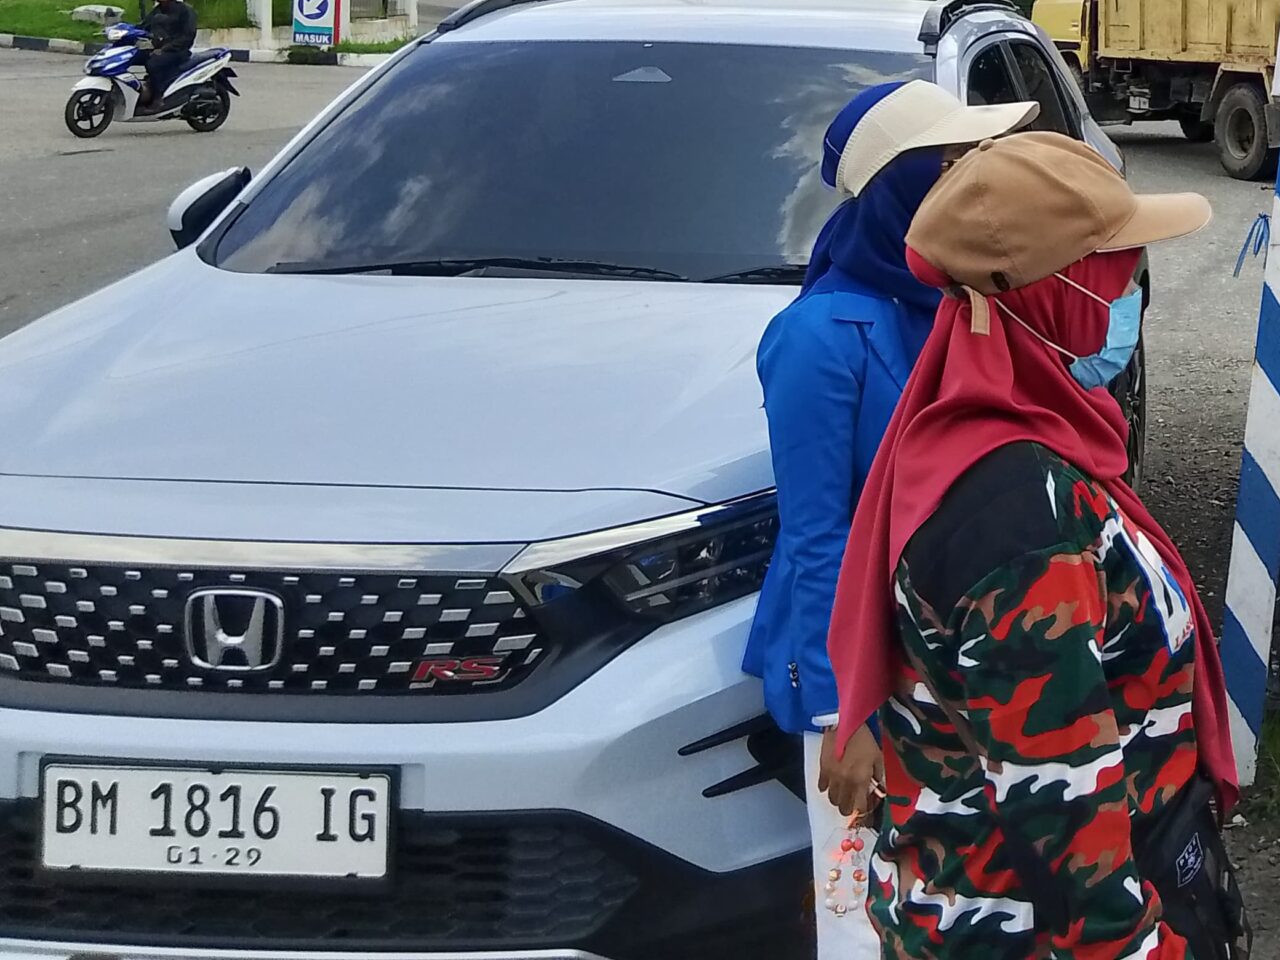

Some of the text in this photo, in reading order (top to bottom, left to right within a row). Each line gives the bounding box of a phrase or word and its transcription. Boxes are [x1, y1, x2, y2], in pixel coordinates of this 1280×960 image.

[295, 31, 330, 45] MASUK
[412, 654, 508, 683] RS
[55, 778, 378, 844] BM 1816 IG
